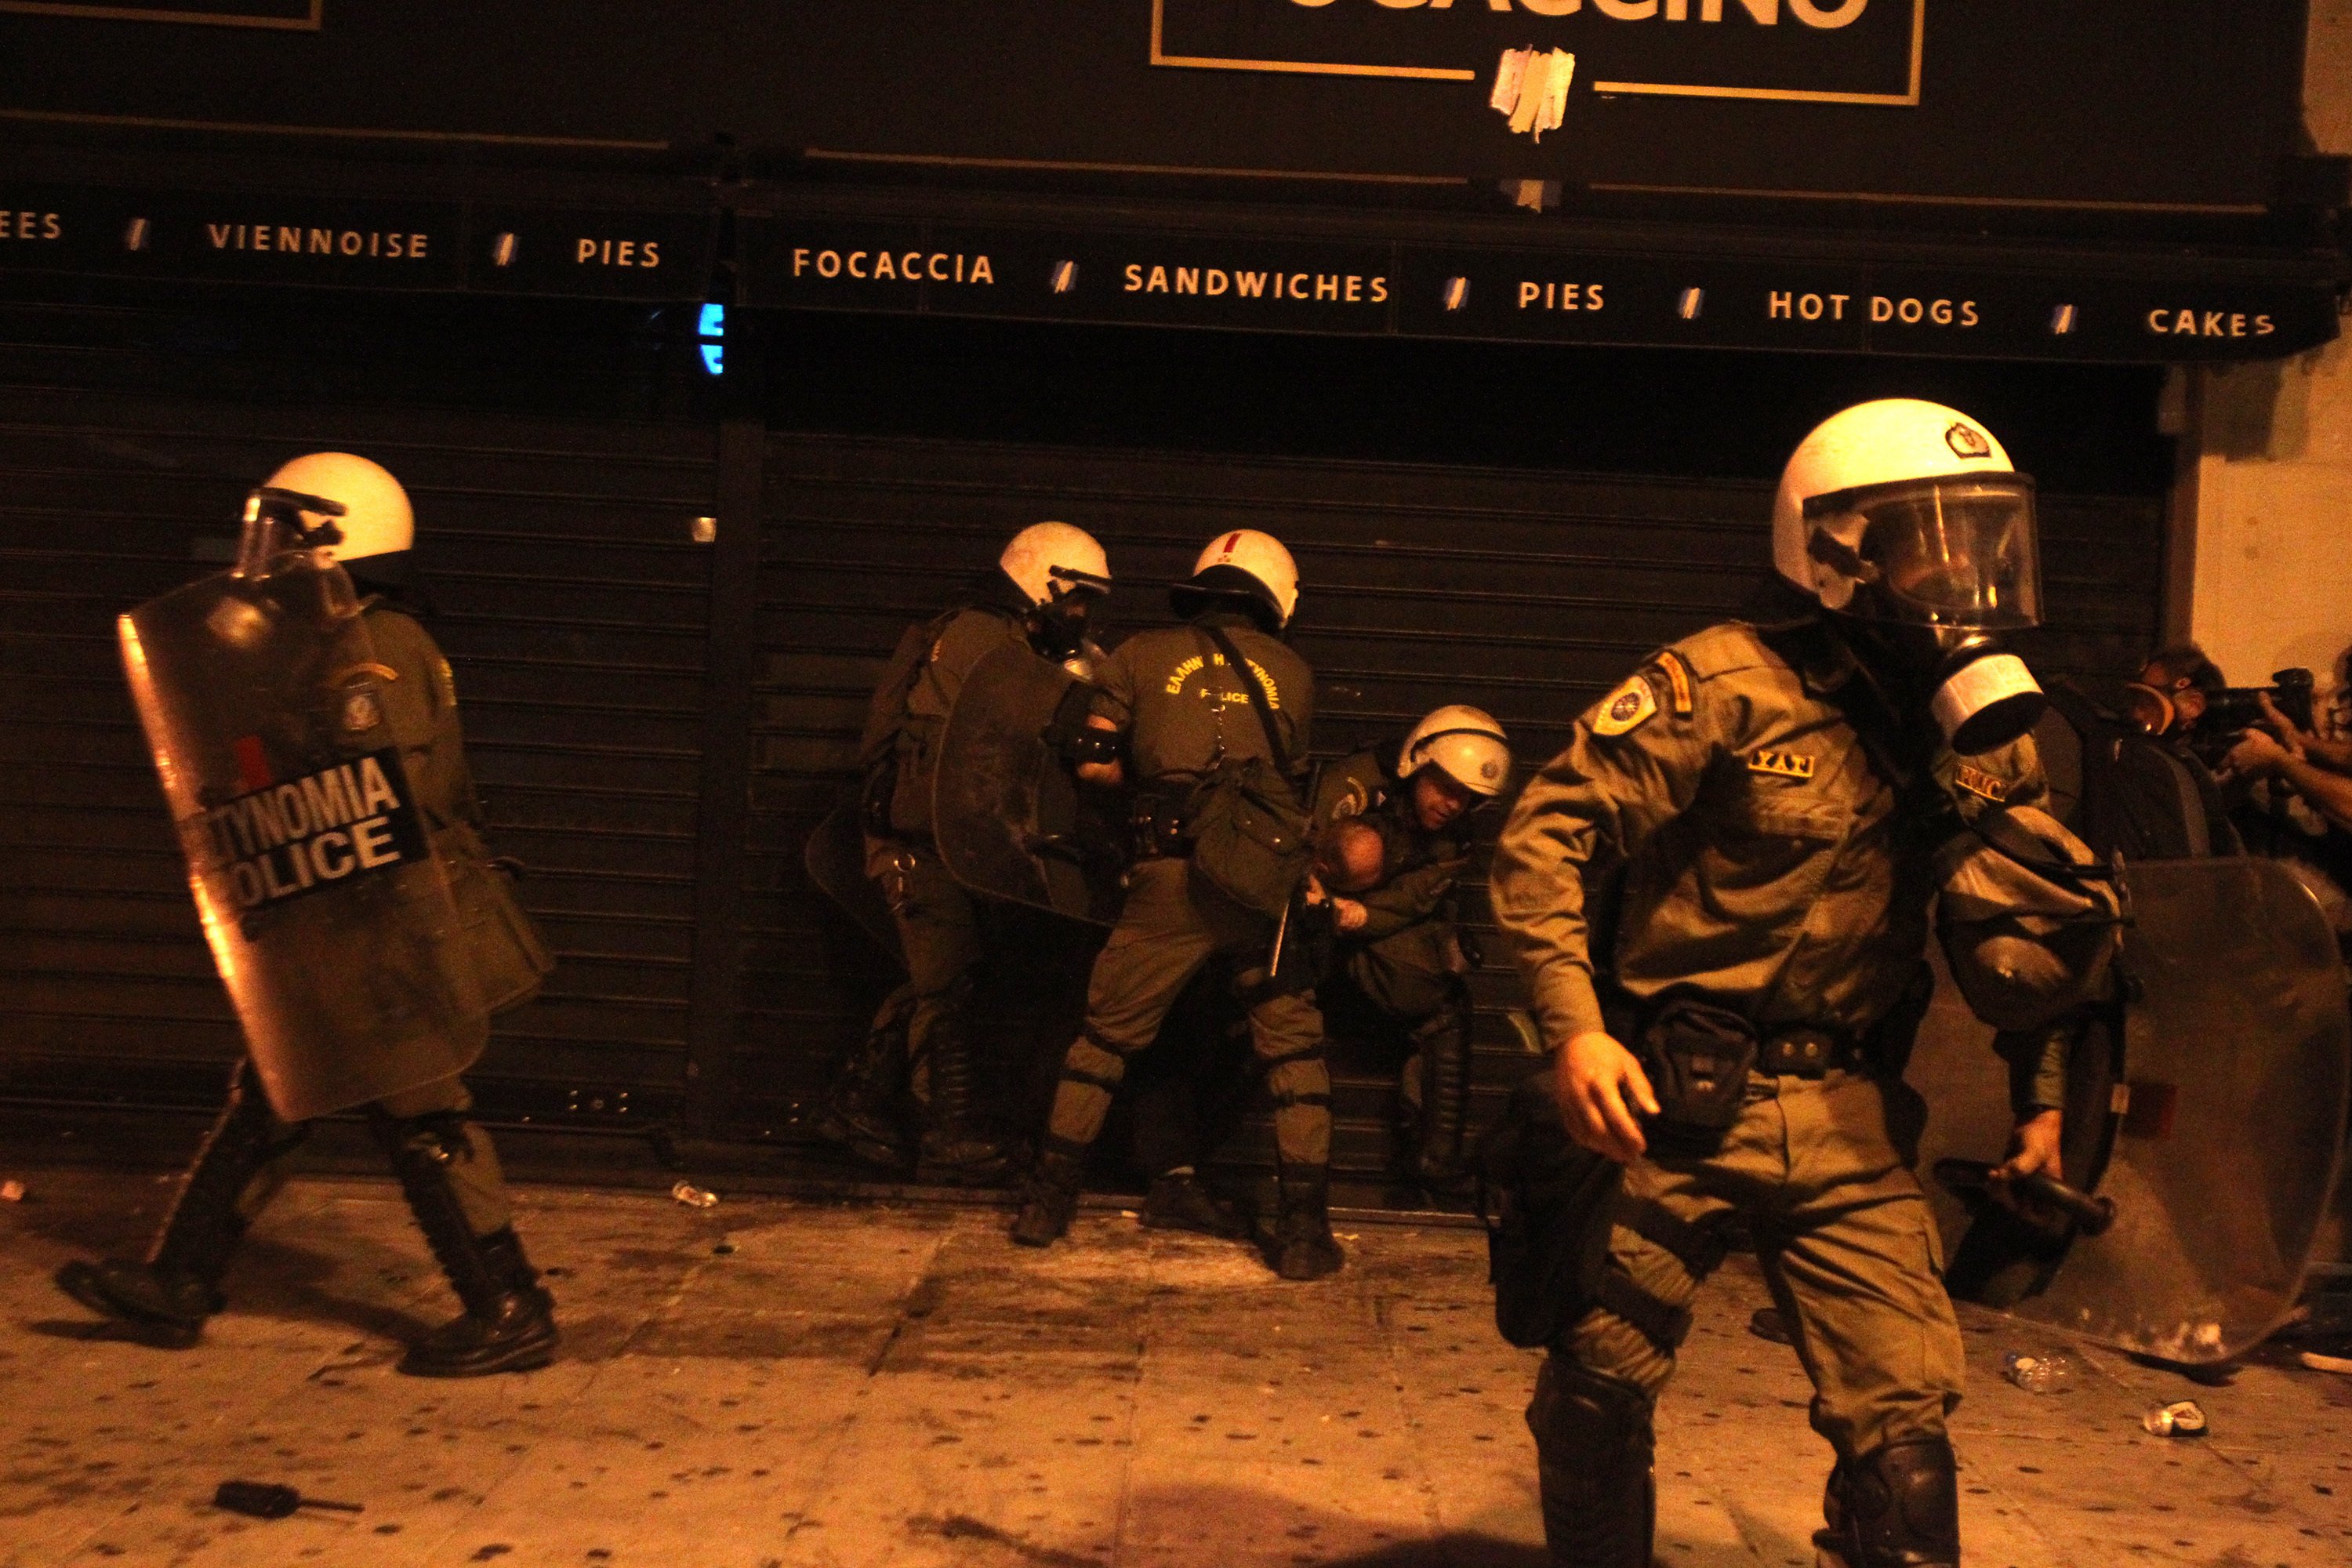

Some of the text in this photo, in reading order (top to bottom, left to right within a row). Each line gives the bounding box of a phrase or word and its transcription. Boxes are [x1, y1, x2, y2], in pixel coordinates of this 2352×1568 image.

[209, 223, 428, 260] VIENNOISE
[576, 238, 661, 268] PIES
[793, 248, 2276, 337] FOCACCIA SANDWICHES PIES HOT DOGS CAKES
[229, 815, 403, 908] OLICE
